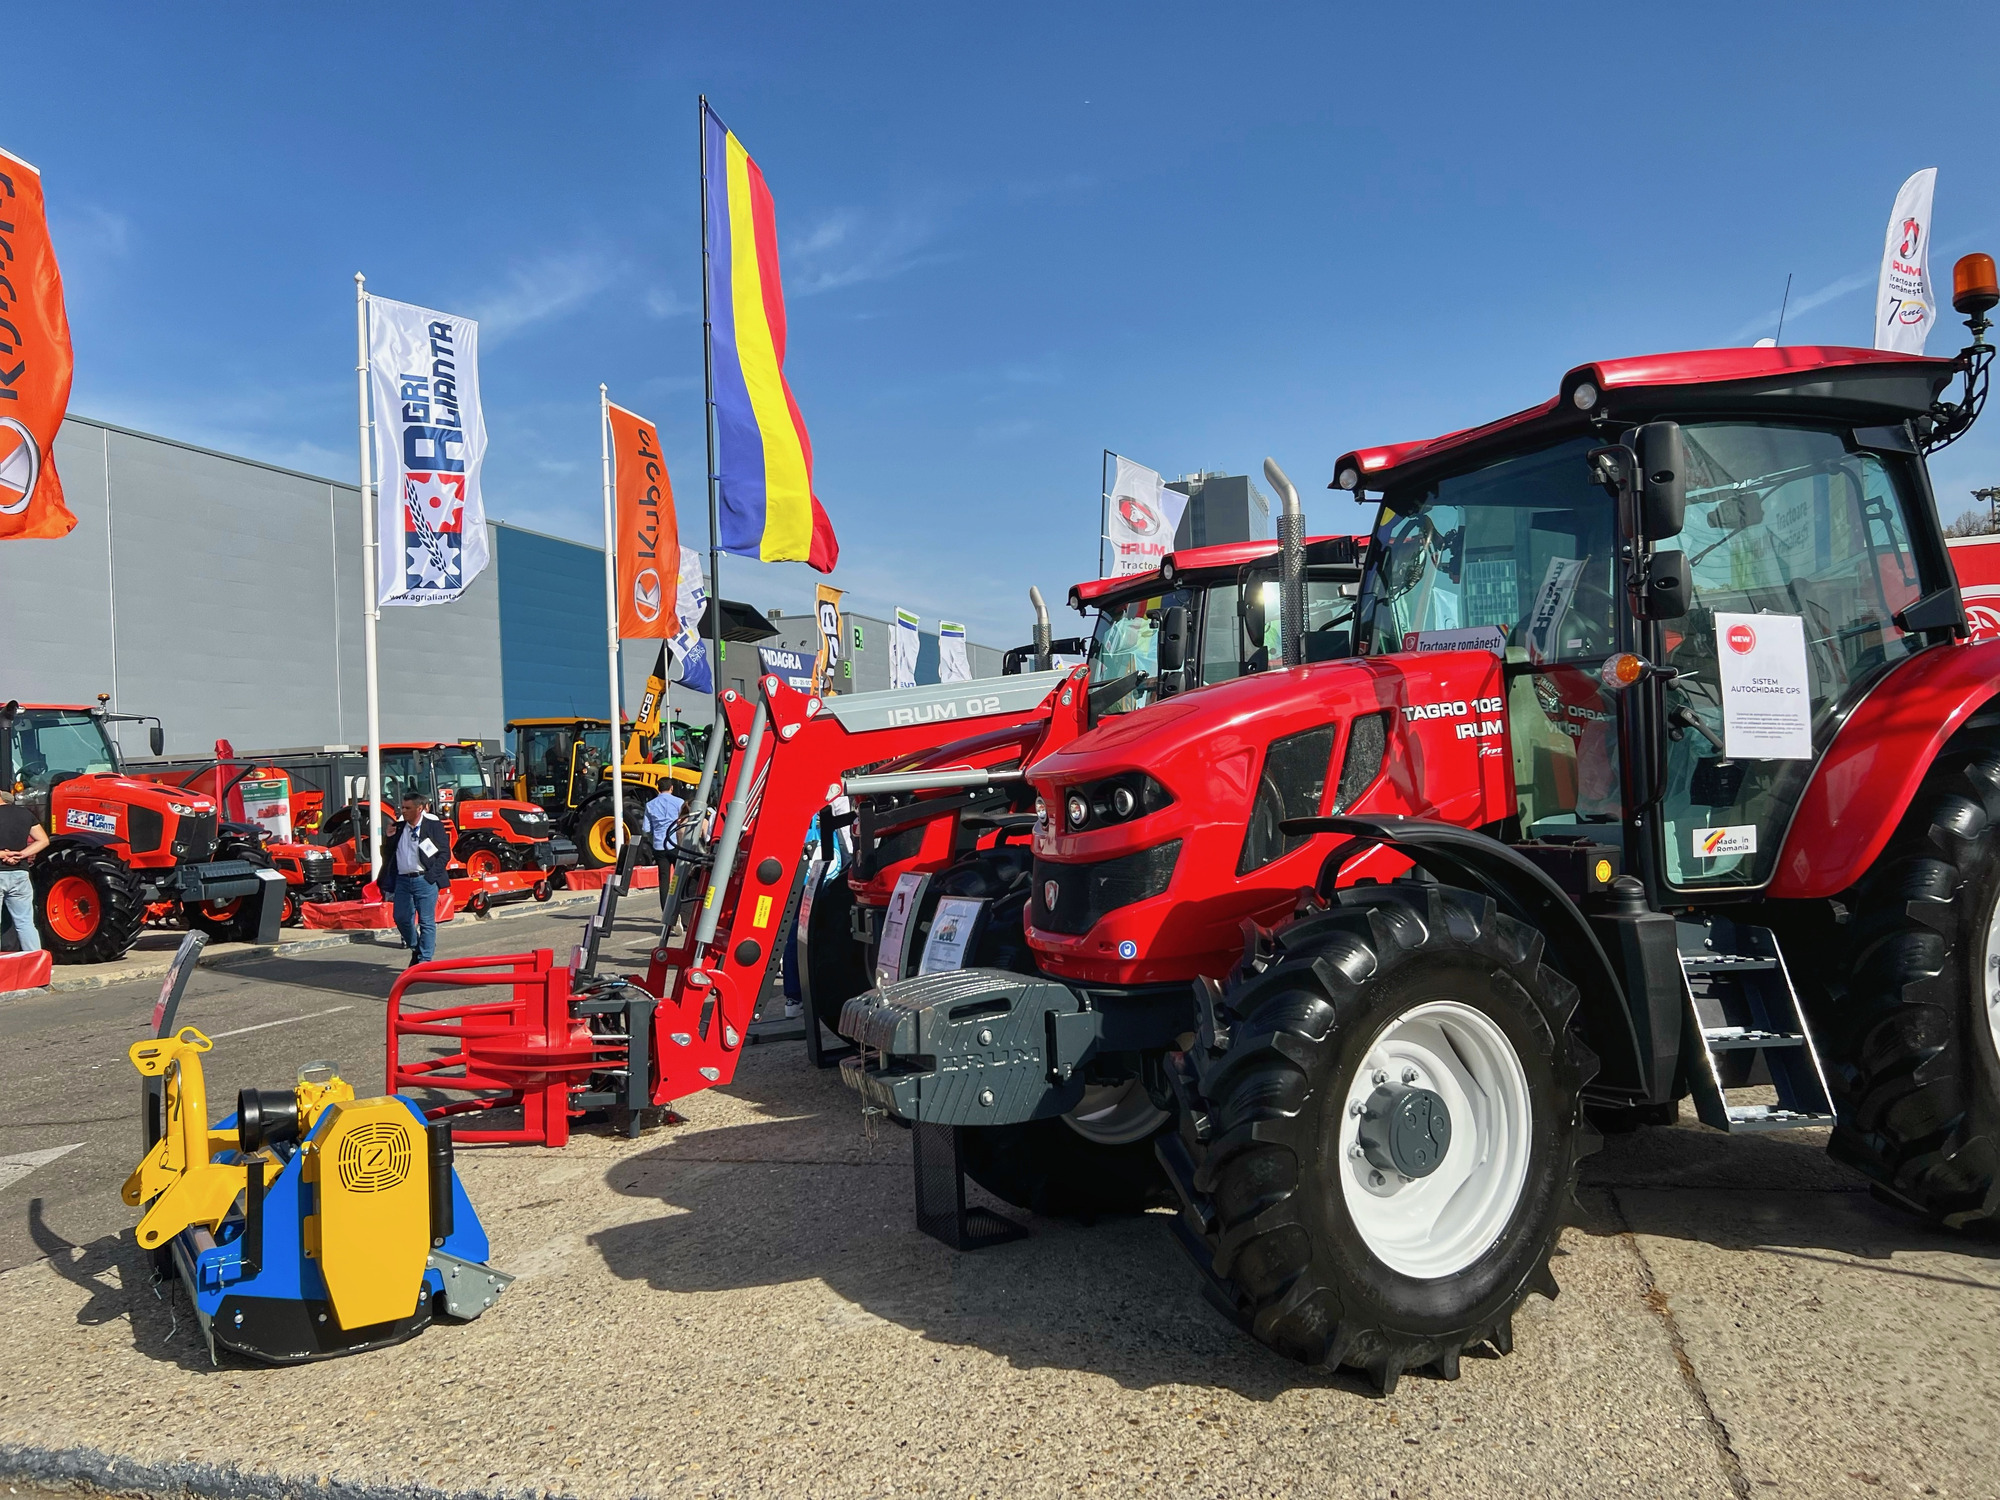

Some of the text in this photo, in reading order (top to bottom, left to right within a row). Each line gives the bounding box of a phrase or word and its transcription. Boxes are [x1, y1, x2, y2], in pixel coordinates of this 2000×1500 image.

[637, 428, 661, 559] Kubota
[1120, 542, 1166, 557] IRUM
[1120, 560, 1161, 570] Tractoar
[1731, 635, 1751, 643] NEW
[1419, 640, 1456, 652] Tractoare
[1752, 678, 1778, 686] SISTEM
[639, 693, 655, 723] JCB
[887, 697, 1001, 726] IRUM 02
[1401, 697, 1504, 721] TAGRO 102
[1456, 719, 1504, 739] IRUM
[531, 785, 556, 794] JCB
[1717, 844, 1749, 852] Romania
